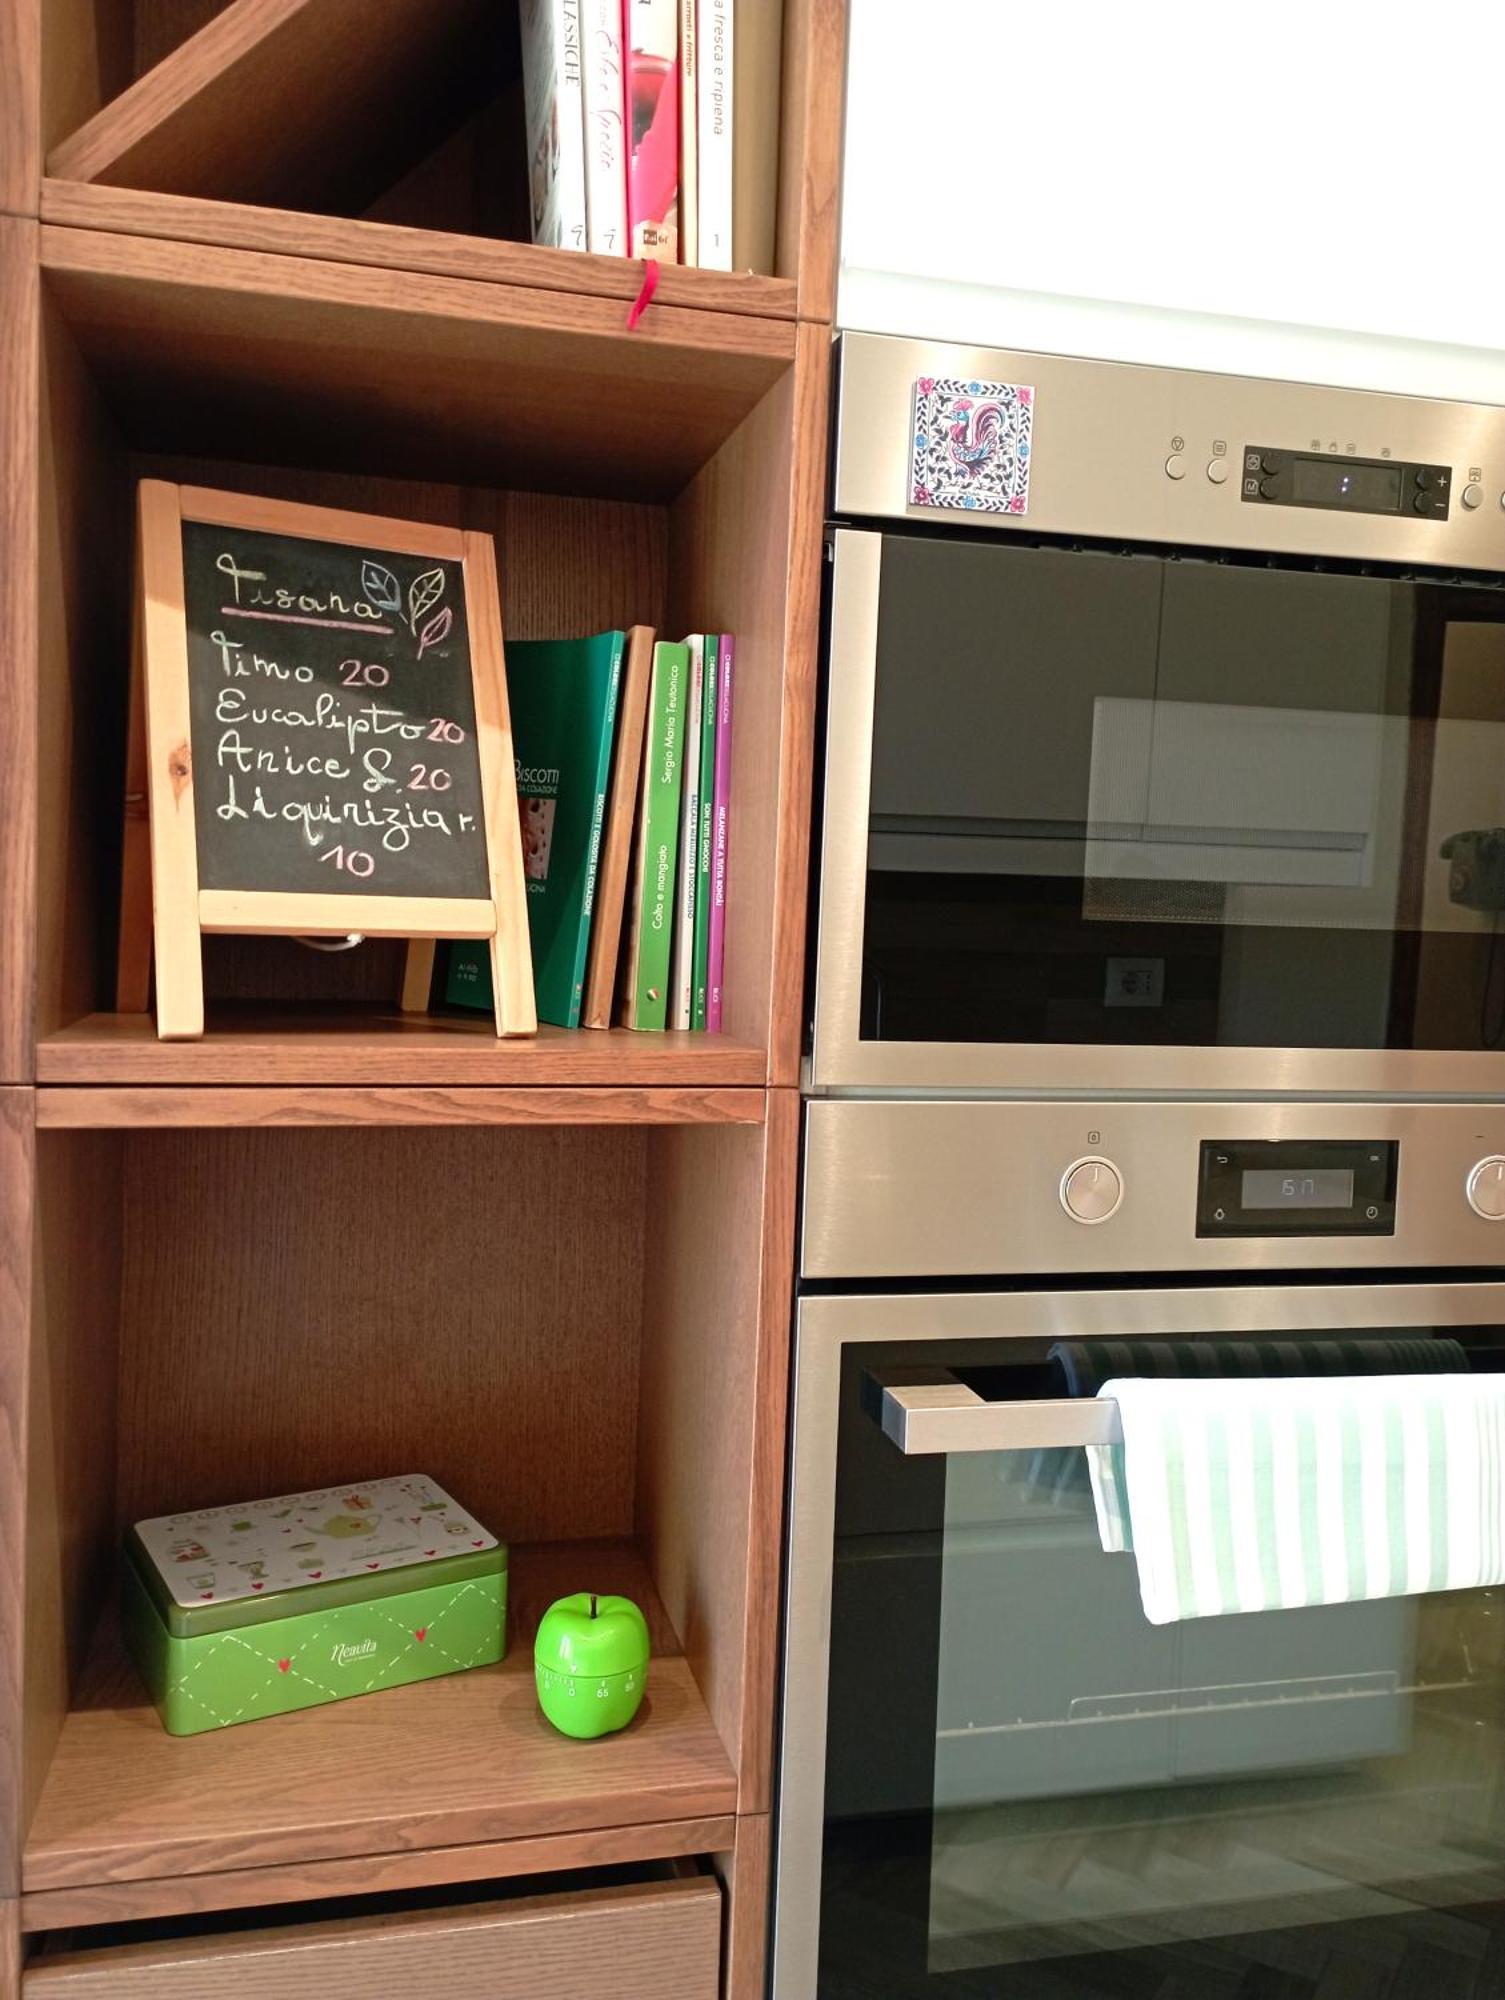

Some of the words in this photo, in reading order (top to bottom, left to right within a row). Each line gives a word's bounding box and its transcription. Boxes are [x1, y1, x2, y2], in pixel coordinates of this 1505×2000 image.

[713, 13, 726, 62] fresca
[713, 66, 724, 76] e
[709, 80, 724, 136] ripiena
[216, 553, 383, 620] Tisana
[211, 630, 315, 684] Timo
[338, 659, 391, 687] 20
[666, 664, 680, 714] Teutonico
[215, 687, 425, 755] Eucalipto
[426, 717, 466, 744] 20
[664, 717, 676, 748] Maria
[217, 728, 351, 779] Anice
[406, 763, 452, 791] 20
[661, 751, 676, 784] Sergio
[216, 774, 452, 851] Liquirizia
[317, 844, 376, 877] 10
[656, 844, 669, 891] mangiato
